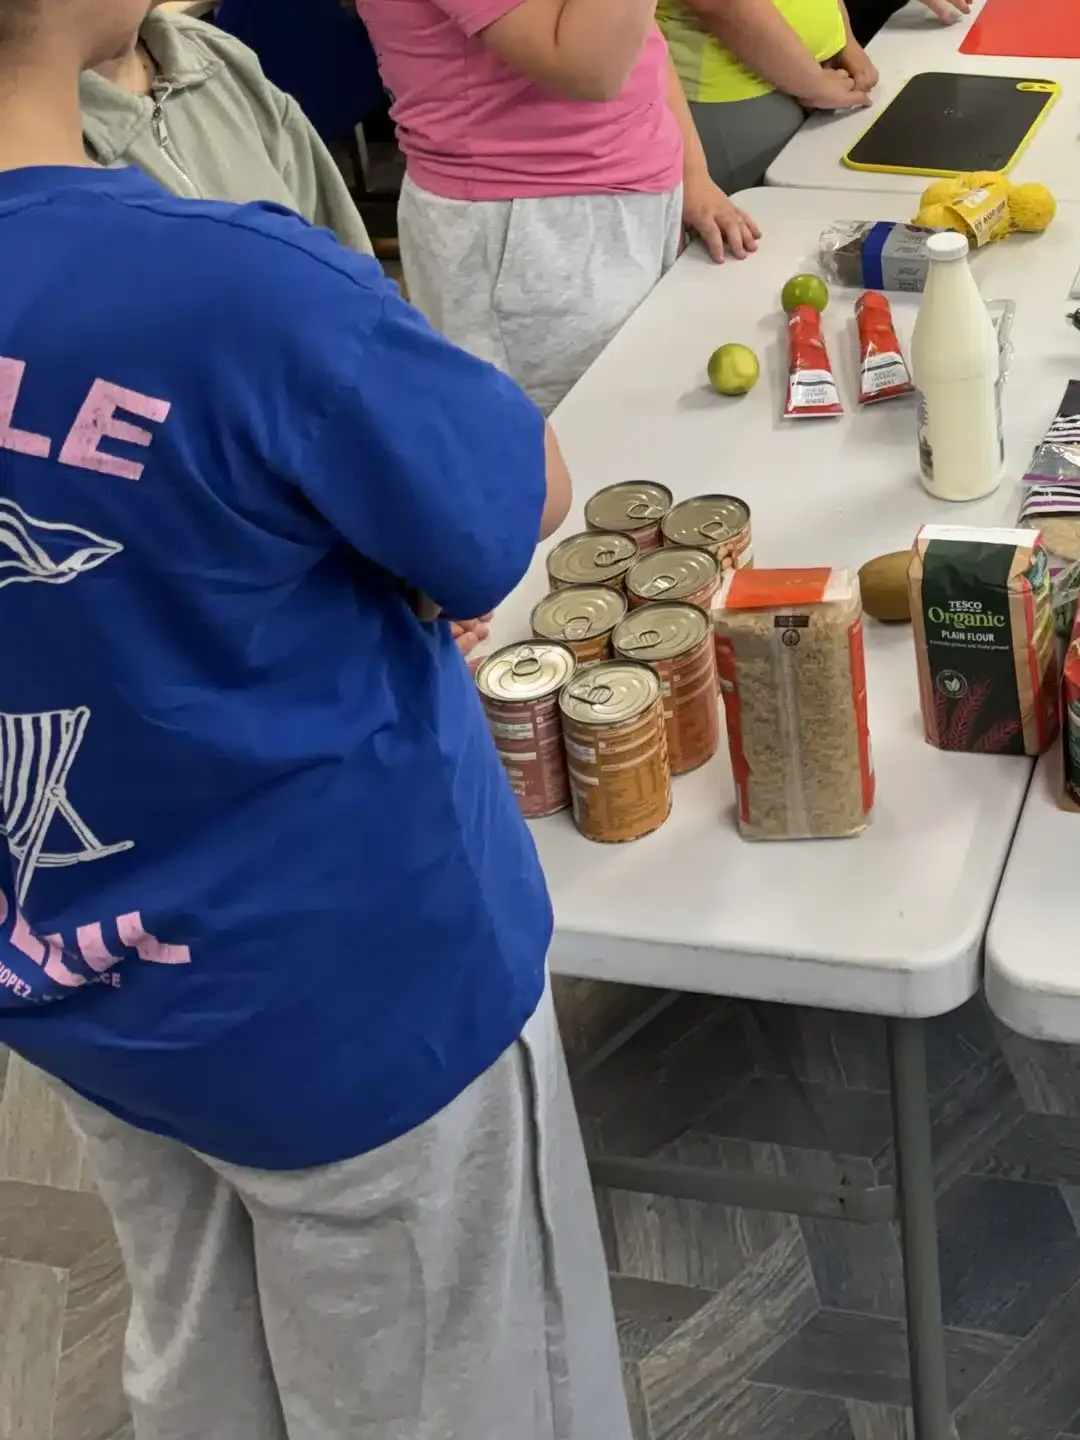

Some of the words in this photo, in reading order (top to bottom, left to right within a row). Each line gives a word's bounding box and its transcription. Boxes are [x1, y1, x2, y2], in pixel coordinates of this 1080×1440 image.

[948, 601, 982, 612] TESCO
[928, 606, 1006, 629] Organic
[941, 630, 965, 640] PLAIN
[967, 633, 995, 642] FLOUR
